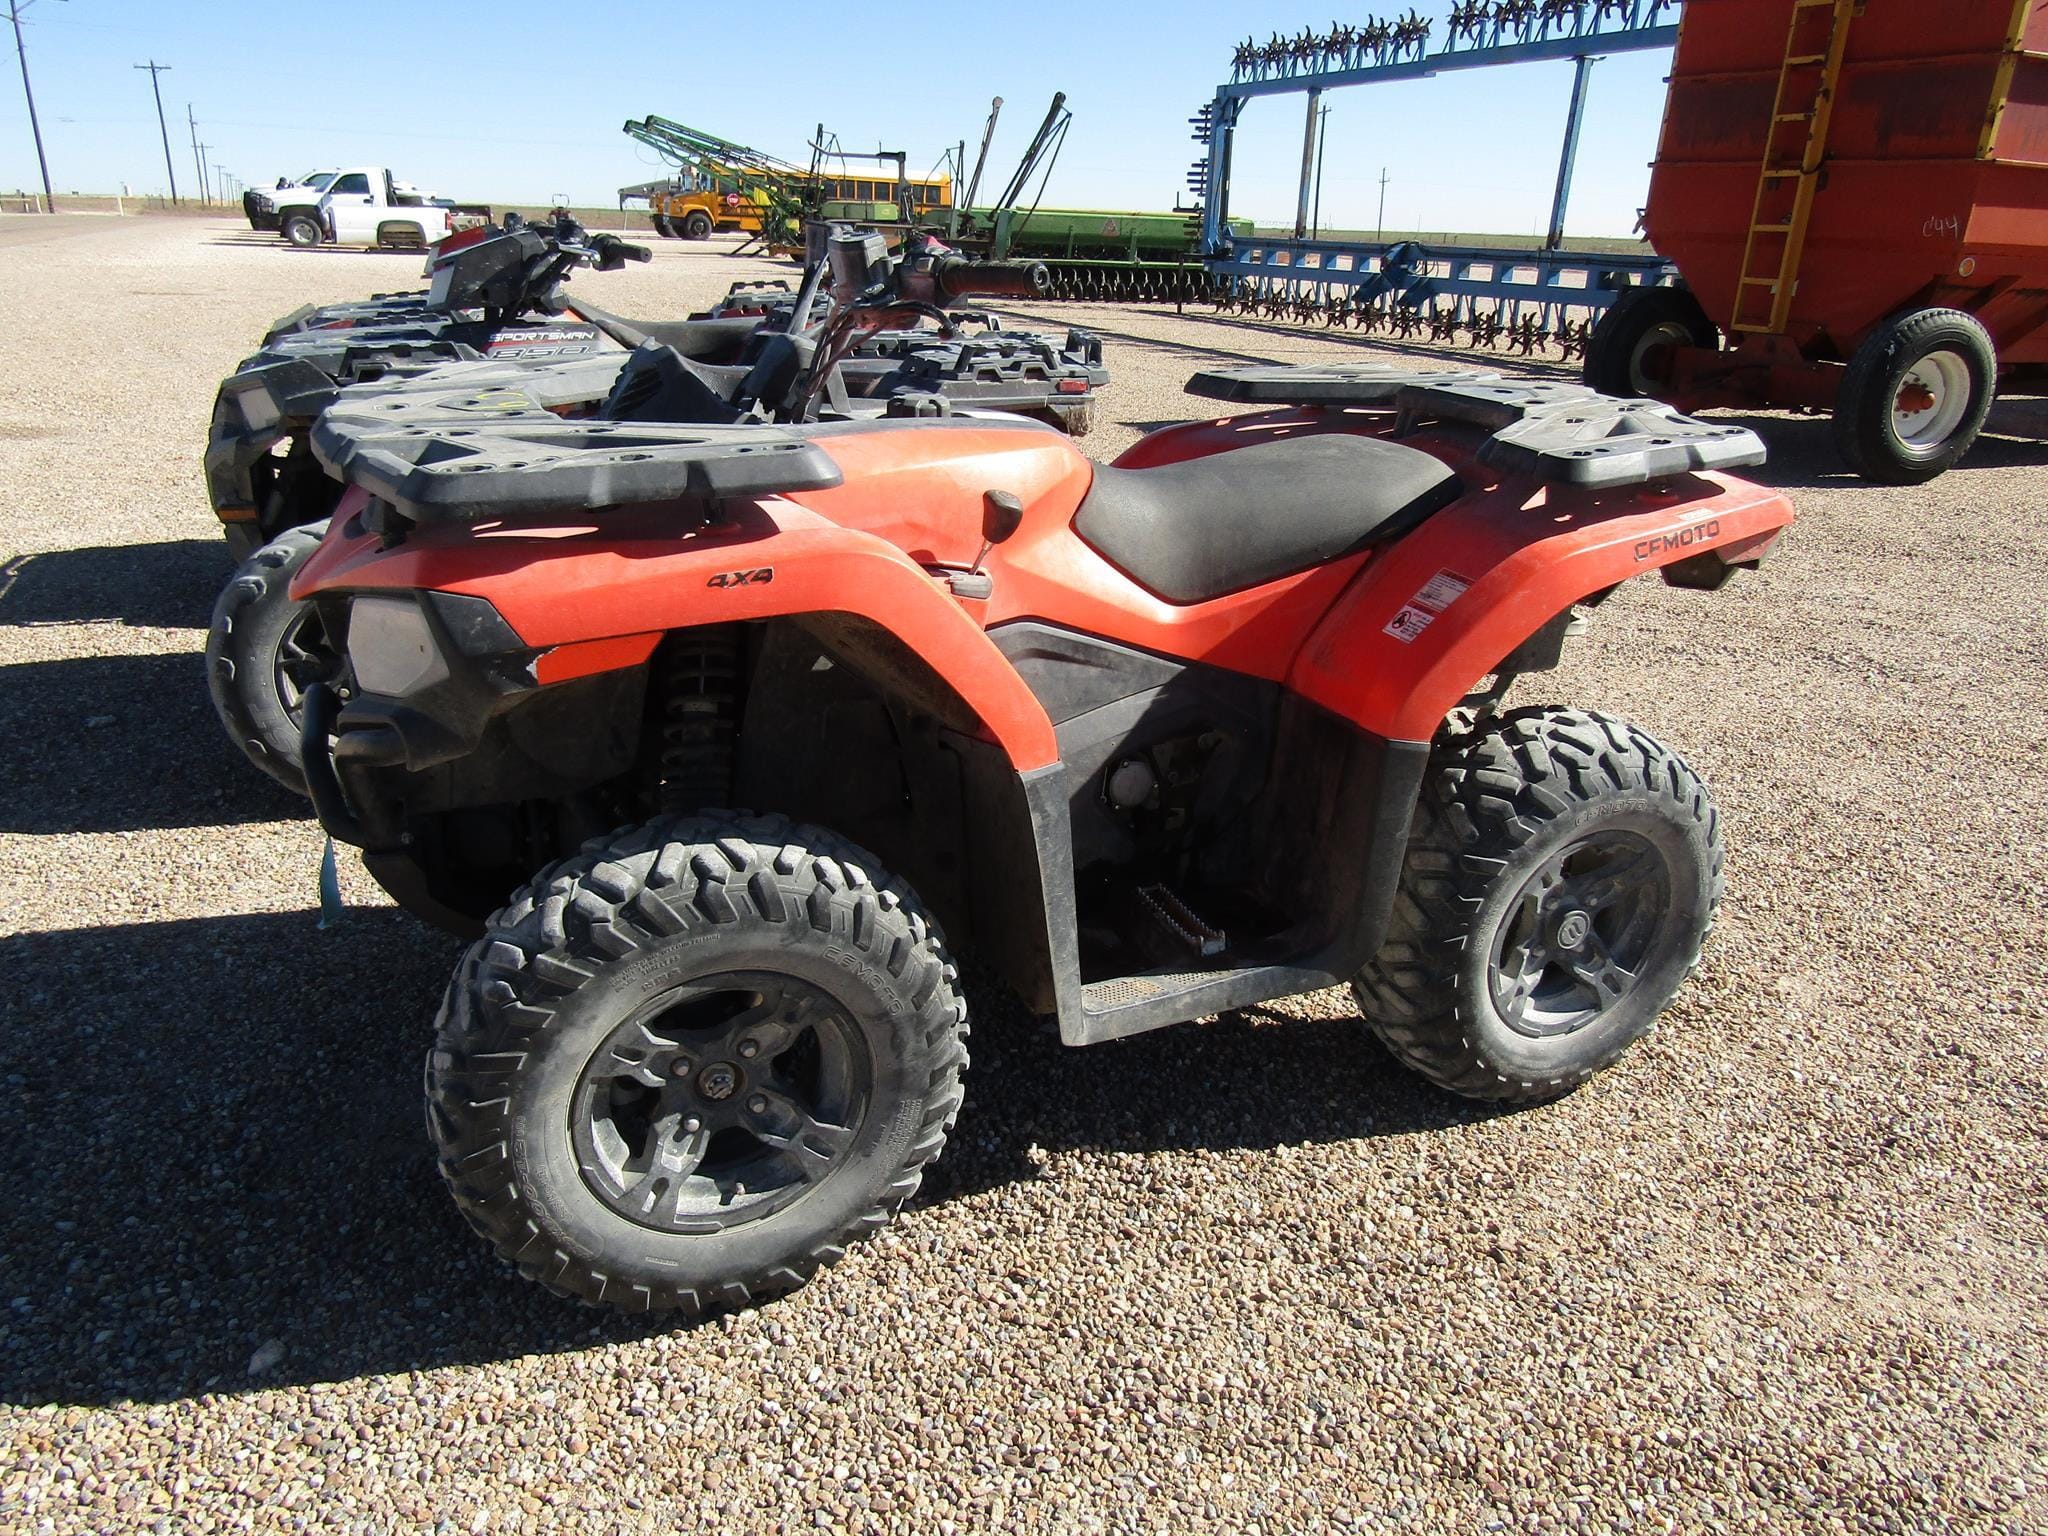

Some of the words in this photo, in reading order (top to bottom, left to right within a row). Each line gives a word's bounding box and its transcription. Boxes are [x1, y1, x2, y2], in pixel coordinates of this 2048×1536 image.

[489, 332, 595, 342] SPORTSMAN
[491, 345, 591, 360] 850
[1634, 520, 1720, 560] CFMOTO
[822, 944, 904, 1016] CFMOTO
